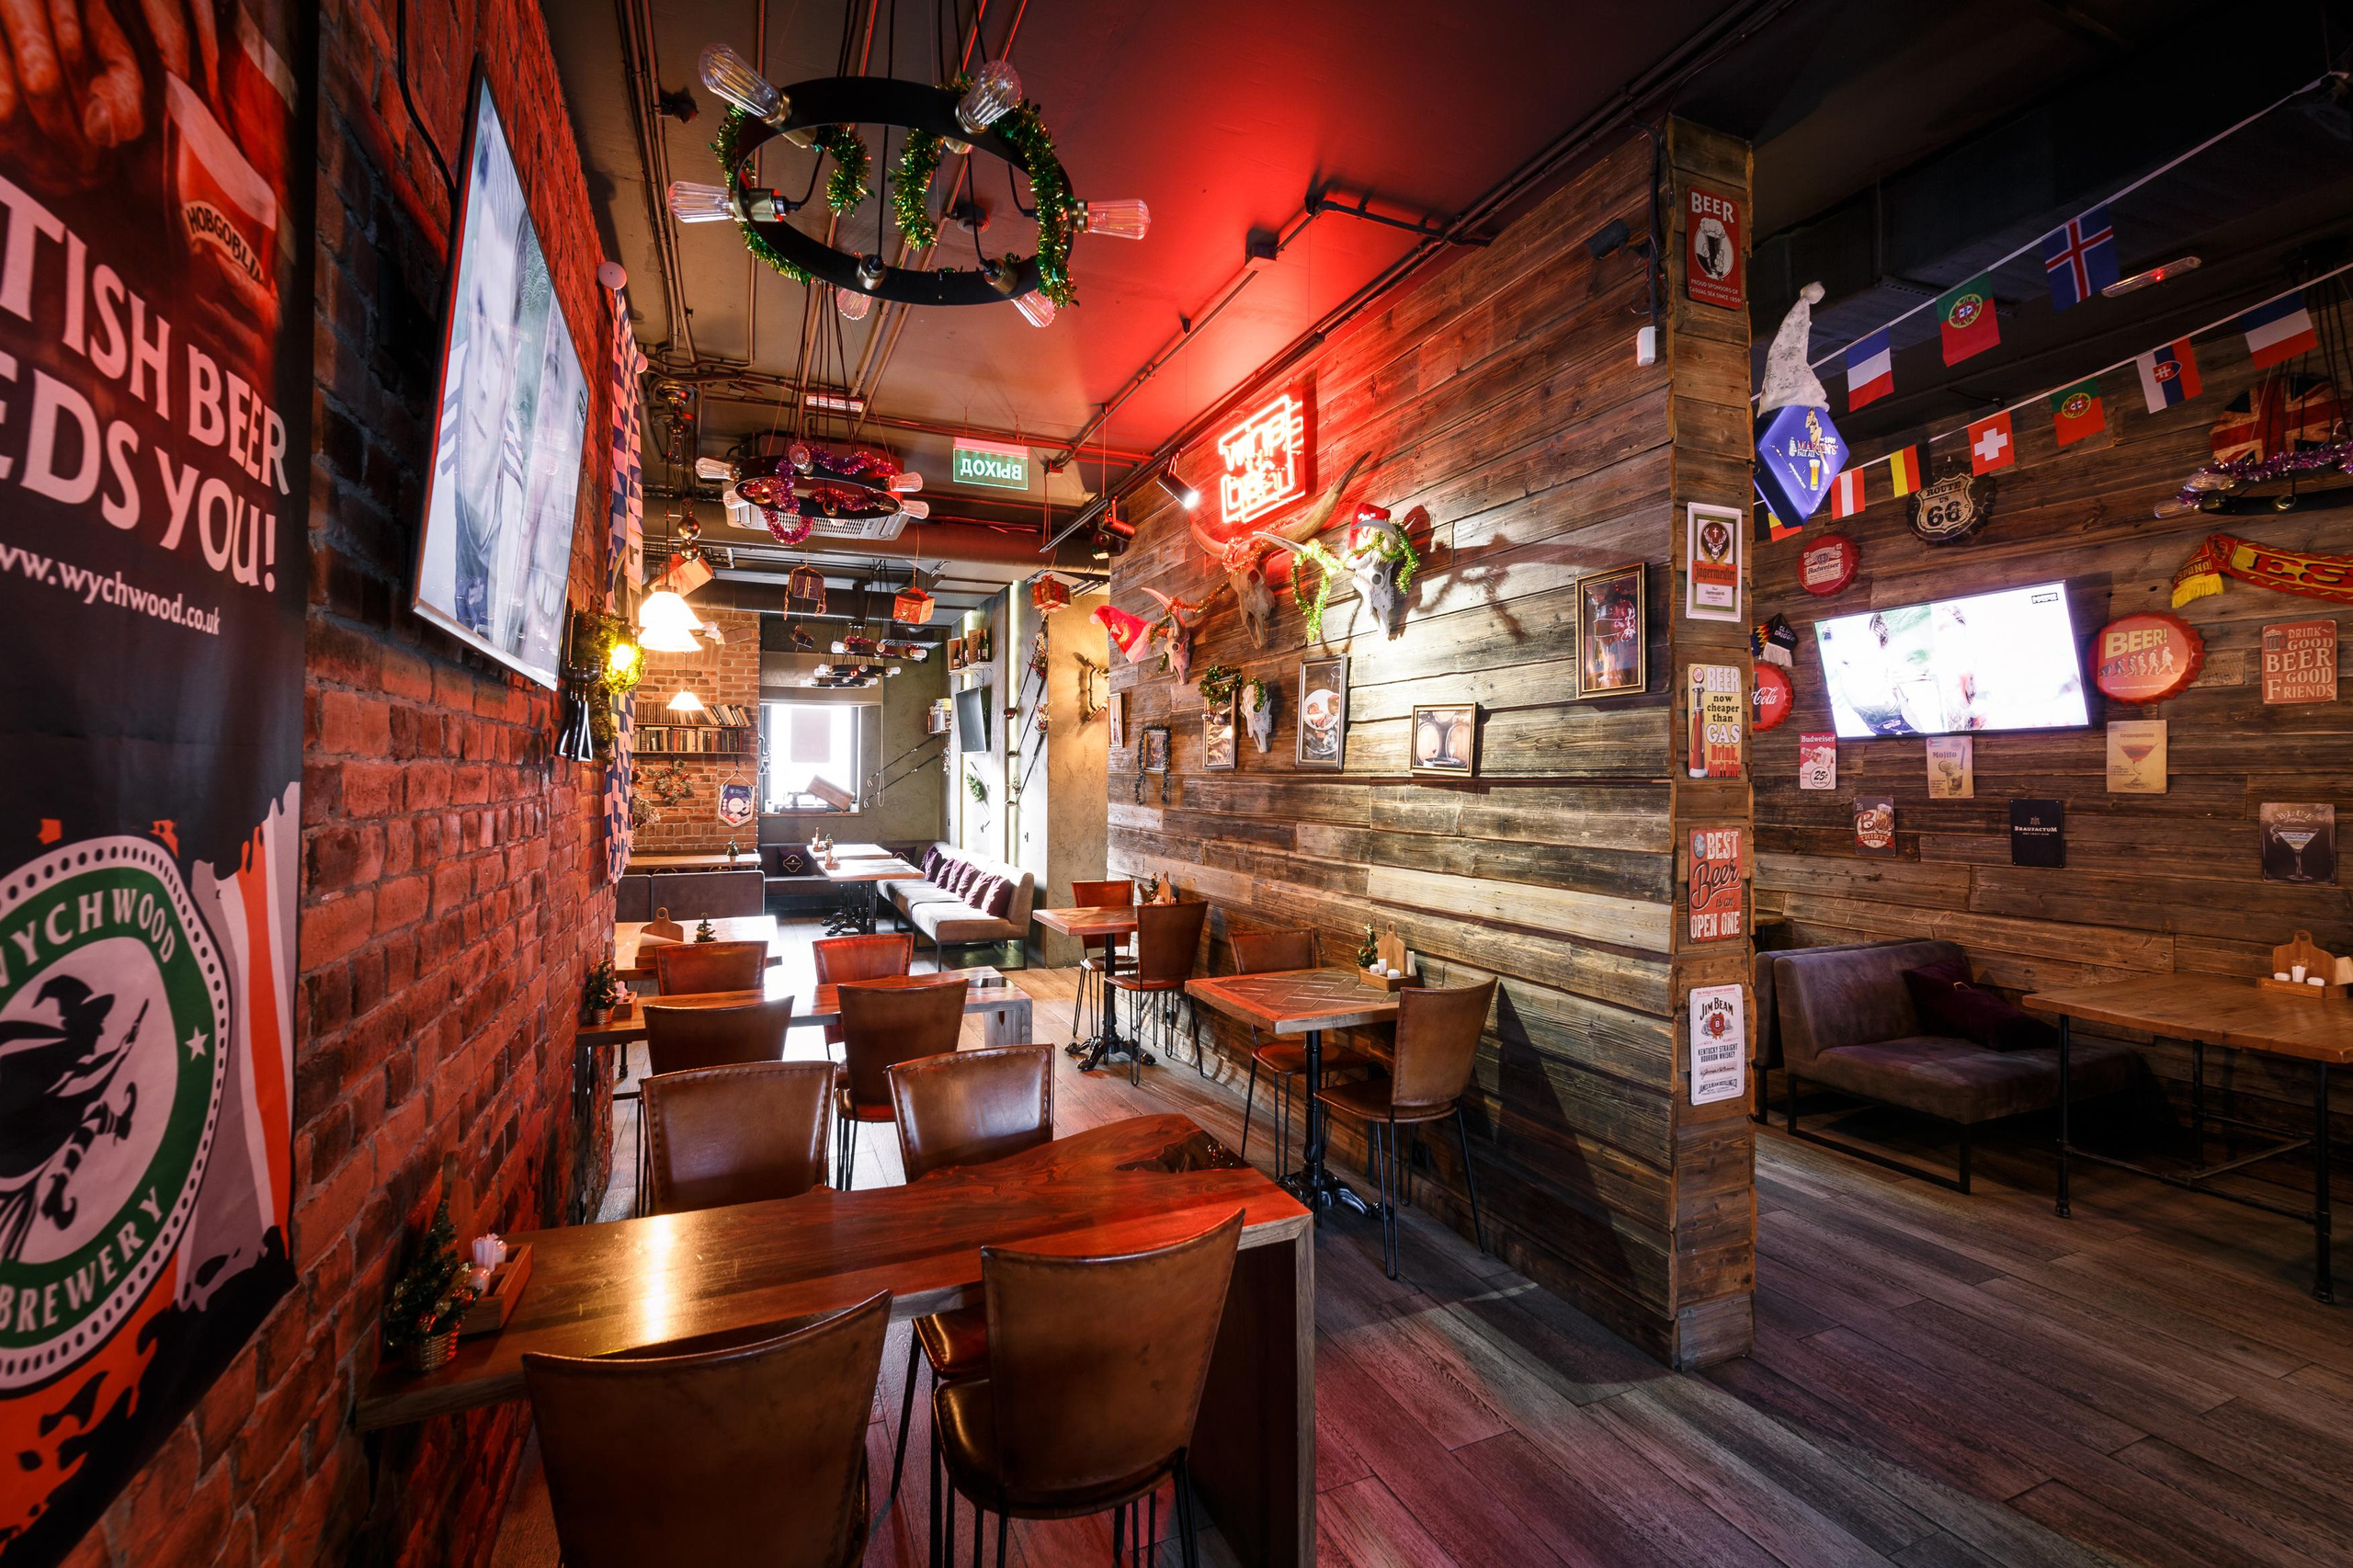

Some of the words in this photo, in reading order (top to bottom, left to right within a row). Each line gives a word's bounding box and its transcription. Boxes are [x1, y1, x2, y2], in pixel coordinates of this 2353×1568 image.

[1691, 191, 1734, 223] BEER
[188, 343, 290, 494] BEER
[1927, 481, 1961, 496] ROUTE
[154, 446, 276, 593] YOU!
[1927, 501, 1962, 527] 66
[2105, 628, 2167, 659] BEER!
[2288, 627, 2322, 639] DRINK
[2287, 637, 2334, 651] GOOD
[2265, 648, 2333, 673] BEER
[1706, 666, 1739, 693] BEER
[2286, 667, 2332, 684] GOOD
[1713, 695, 1733, 703] now
[2267, 678, 2335, 699] FRIENDS
[1707, 703, 1739, 713] cheaper
[1712, 713, 1733, 722] than
[1706, 723, 1740, 744] GAS
[1932, 751, 1957, 759] Mojito
[1706, 831, 1739, 860] BEST
[1859, 834, 1890, 842] THIRTY
[1690, 859, 1740, 911] Beer
[1691, 913, 1717, 939] OPEN
[1721, 911, 1740, 936] ONE
[1699, 1001, 1713, 1020] JIM
[1713, 996, 1733, 1016] BEAM
[1698, 1046, 1719, 1056] KENTUCKY
[1719, 1043, 1738, 1053] STRAIGHT
[1700, 1053, 1718, 1062] BOURBON
[1719, 1051, 1735, 1060] WHISKEY
